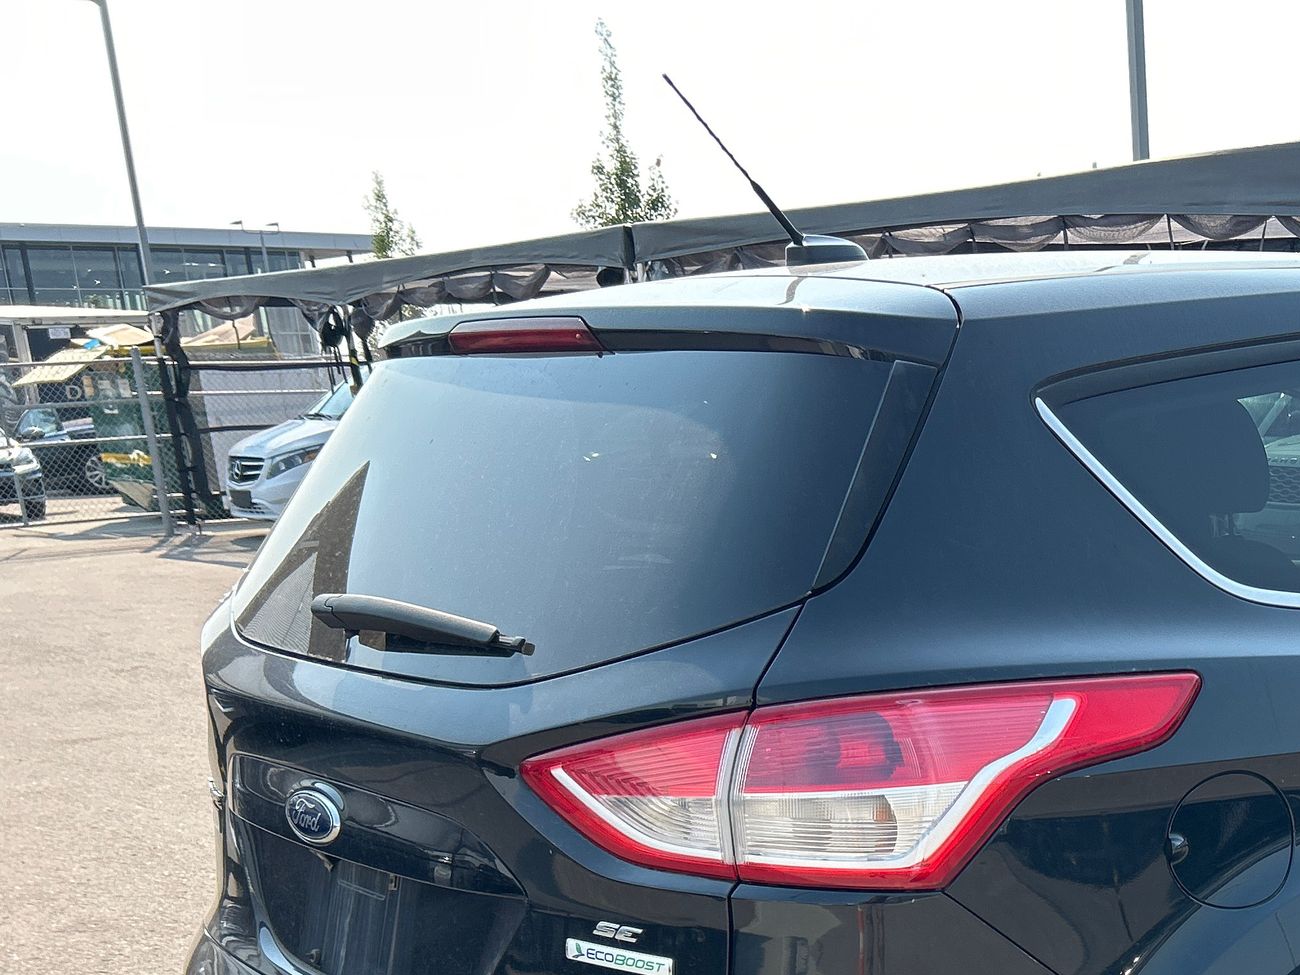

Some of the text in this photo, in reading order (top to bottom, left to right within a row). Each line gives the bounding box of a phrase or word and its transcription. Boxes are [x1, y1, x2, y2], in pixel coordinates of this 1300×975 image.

[292, 798, 321, 832] Ford
[592, 921, 644, 943] SE
[586, 948, 665, 973] ECOBOOST
